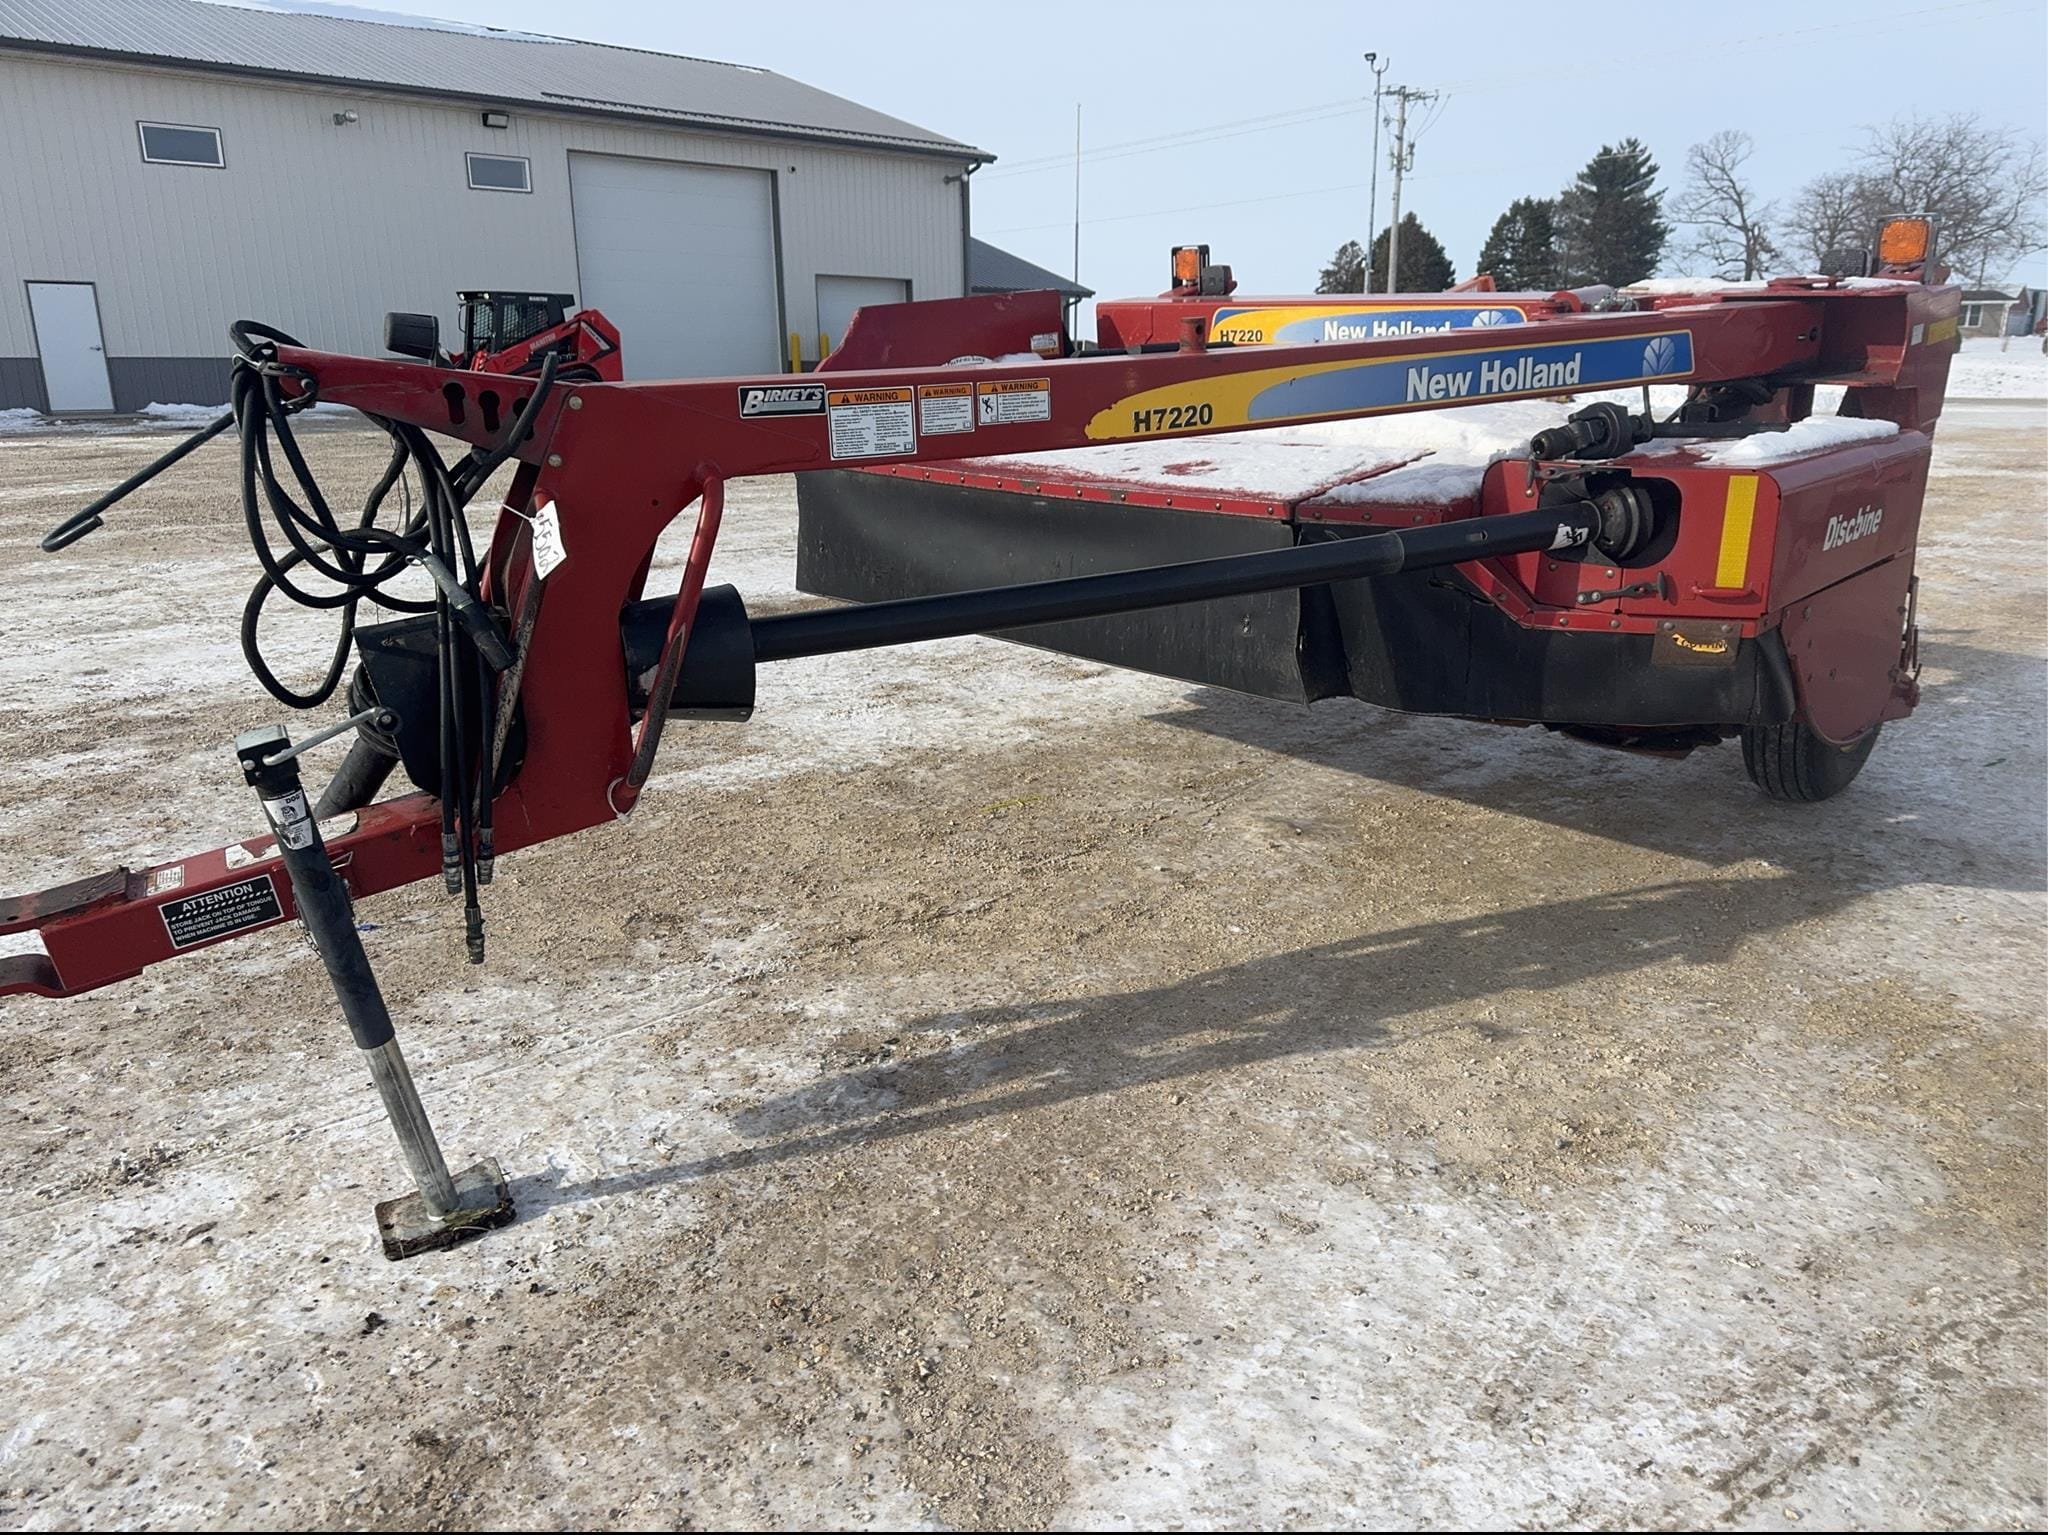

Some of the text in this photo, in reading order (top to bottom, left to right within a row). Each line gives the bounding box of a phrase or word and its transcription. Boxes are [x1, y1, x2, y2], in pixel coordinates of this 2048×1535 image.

[1219, 328, 1263, 344] H7220
[1324, 320, 1367, 342] New
[1001, 381, 1039, 391] WARNING
[1405, 352, 1581, 403] New Holland
[745, 386, 824, 415] BIRKEY'S
[854, 391, 898, 403] WARNING
[933, 388, 967, 396] WARNING
[1132, 403, 1214, 433] H7220
[1822, 504, 1883, 552] Discbine
[183, 884, 254, 912] ATTENTION
[171, 895, 273, 931] STORE JACK ON TOP OF TONGUE
[174, 905, 262, 937] TO PREVENT JACK DAMAGE
[176, 931, 197, 942] WHEN
[197, 922, 227, 936] MACHINE
